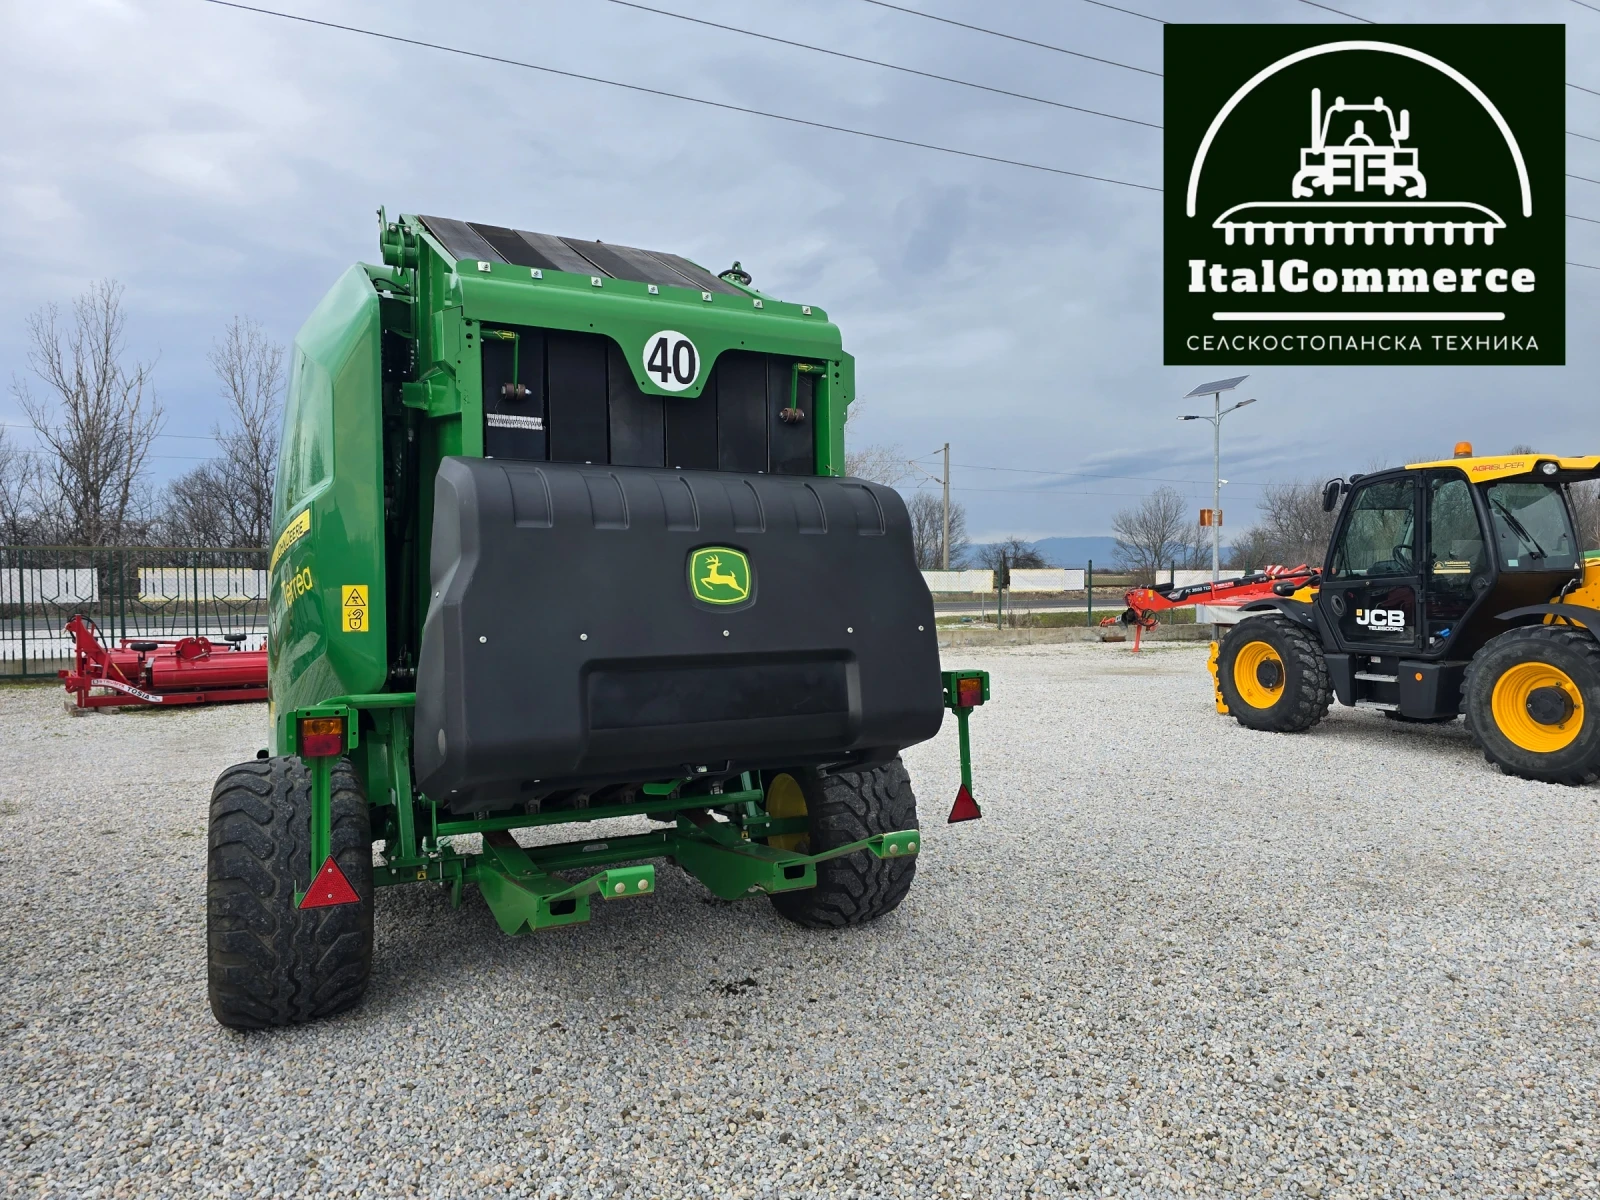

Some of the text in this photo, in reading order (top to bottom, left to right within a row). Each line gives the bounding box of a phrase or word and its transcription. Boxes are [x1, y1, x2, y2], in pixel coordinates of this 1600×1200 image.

[647, 337, 696, 385] 40
[1471, 461, 1525, 472] AGRISUPER
[285, 520, 304, 547] DEERE
[1356, 609, 1405, 626] JCB
[127, 686, 150, 700] TOSIA
